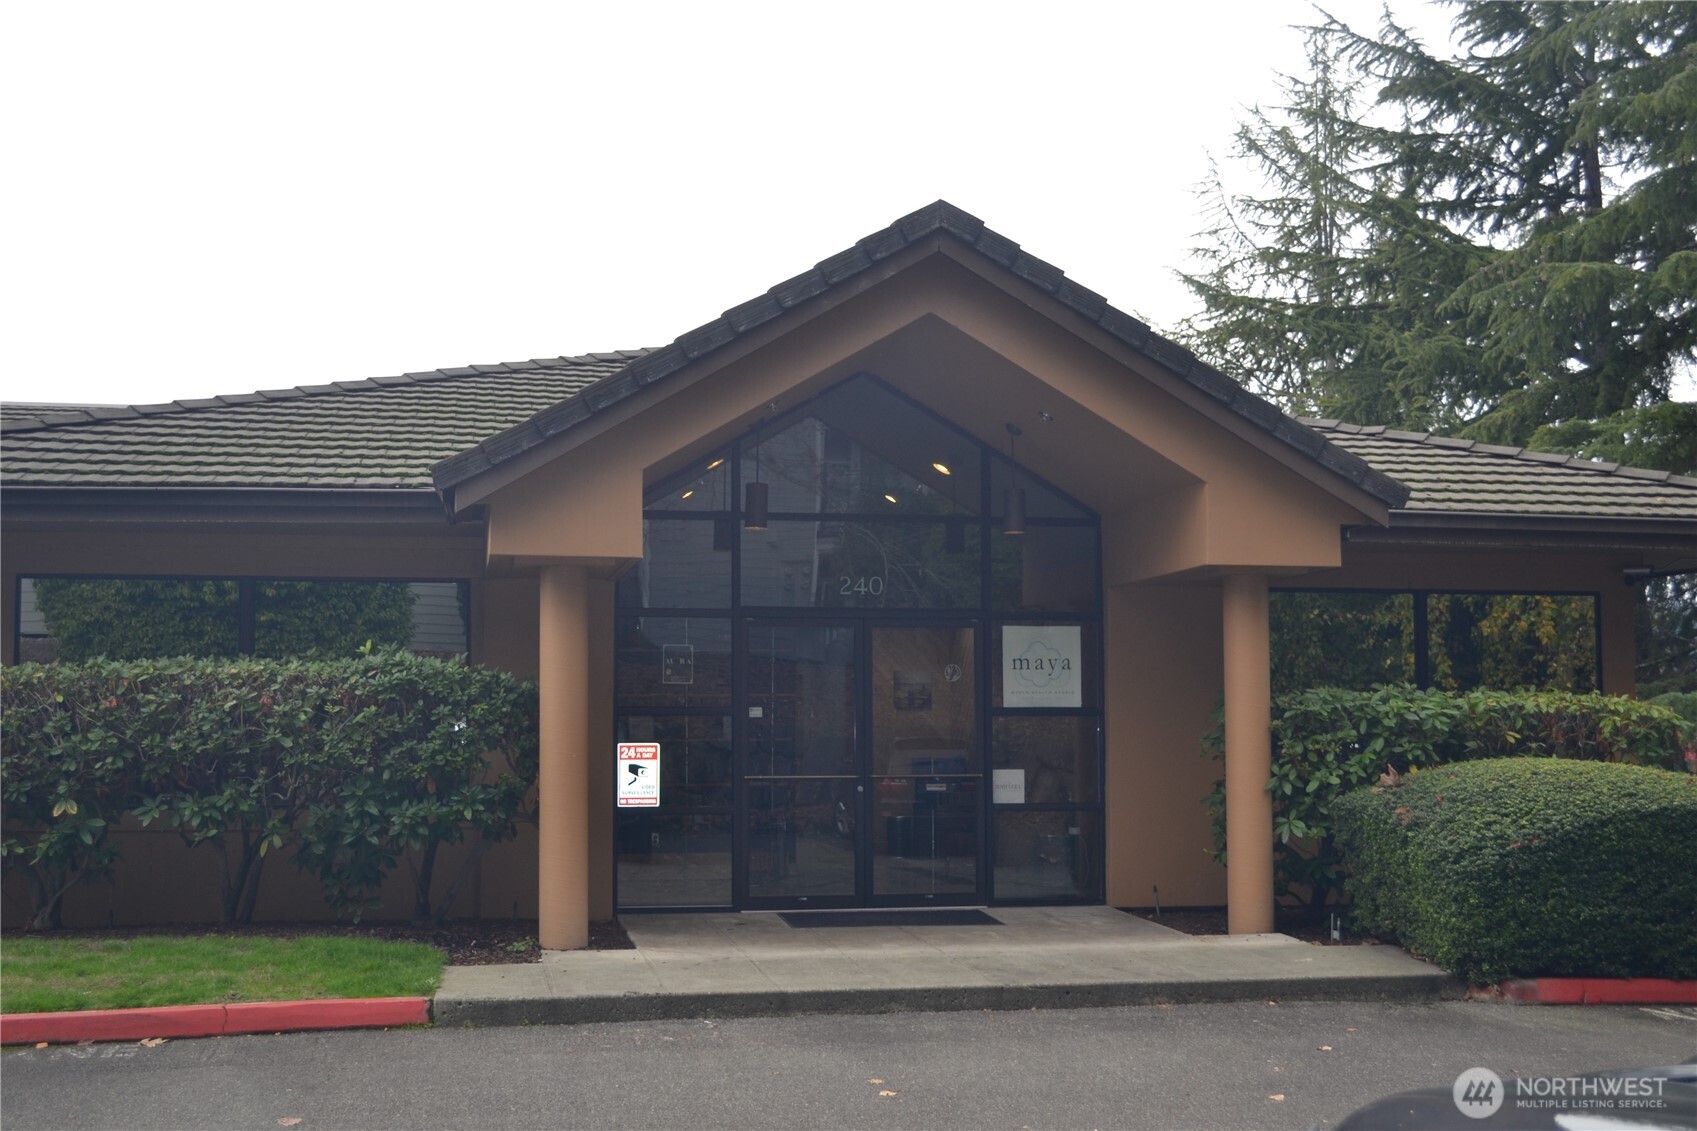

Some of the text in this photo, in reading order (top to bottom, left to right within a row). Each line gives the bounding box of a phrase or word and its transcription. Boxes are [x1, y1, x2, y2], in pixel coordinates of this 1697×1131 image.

[840, 576, 883, 595] 240
[1012, 657, 1071, 676] maya
[620, 746, 636, 758] 24
